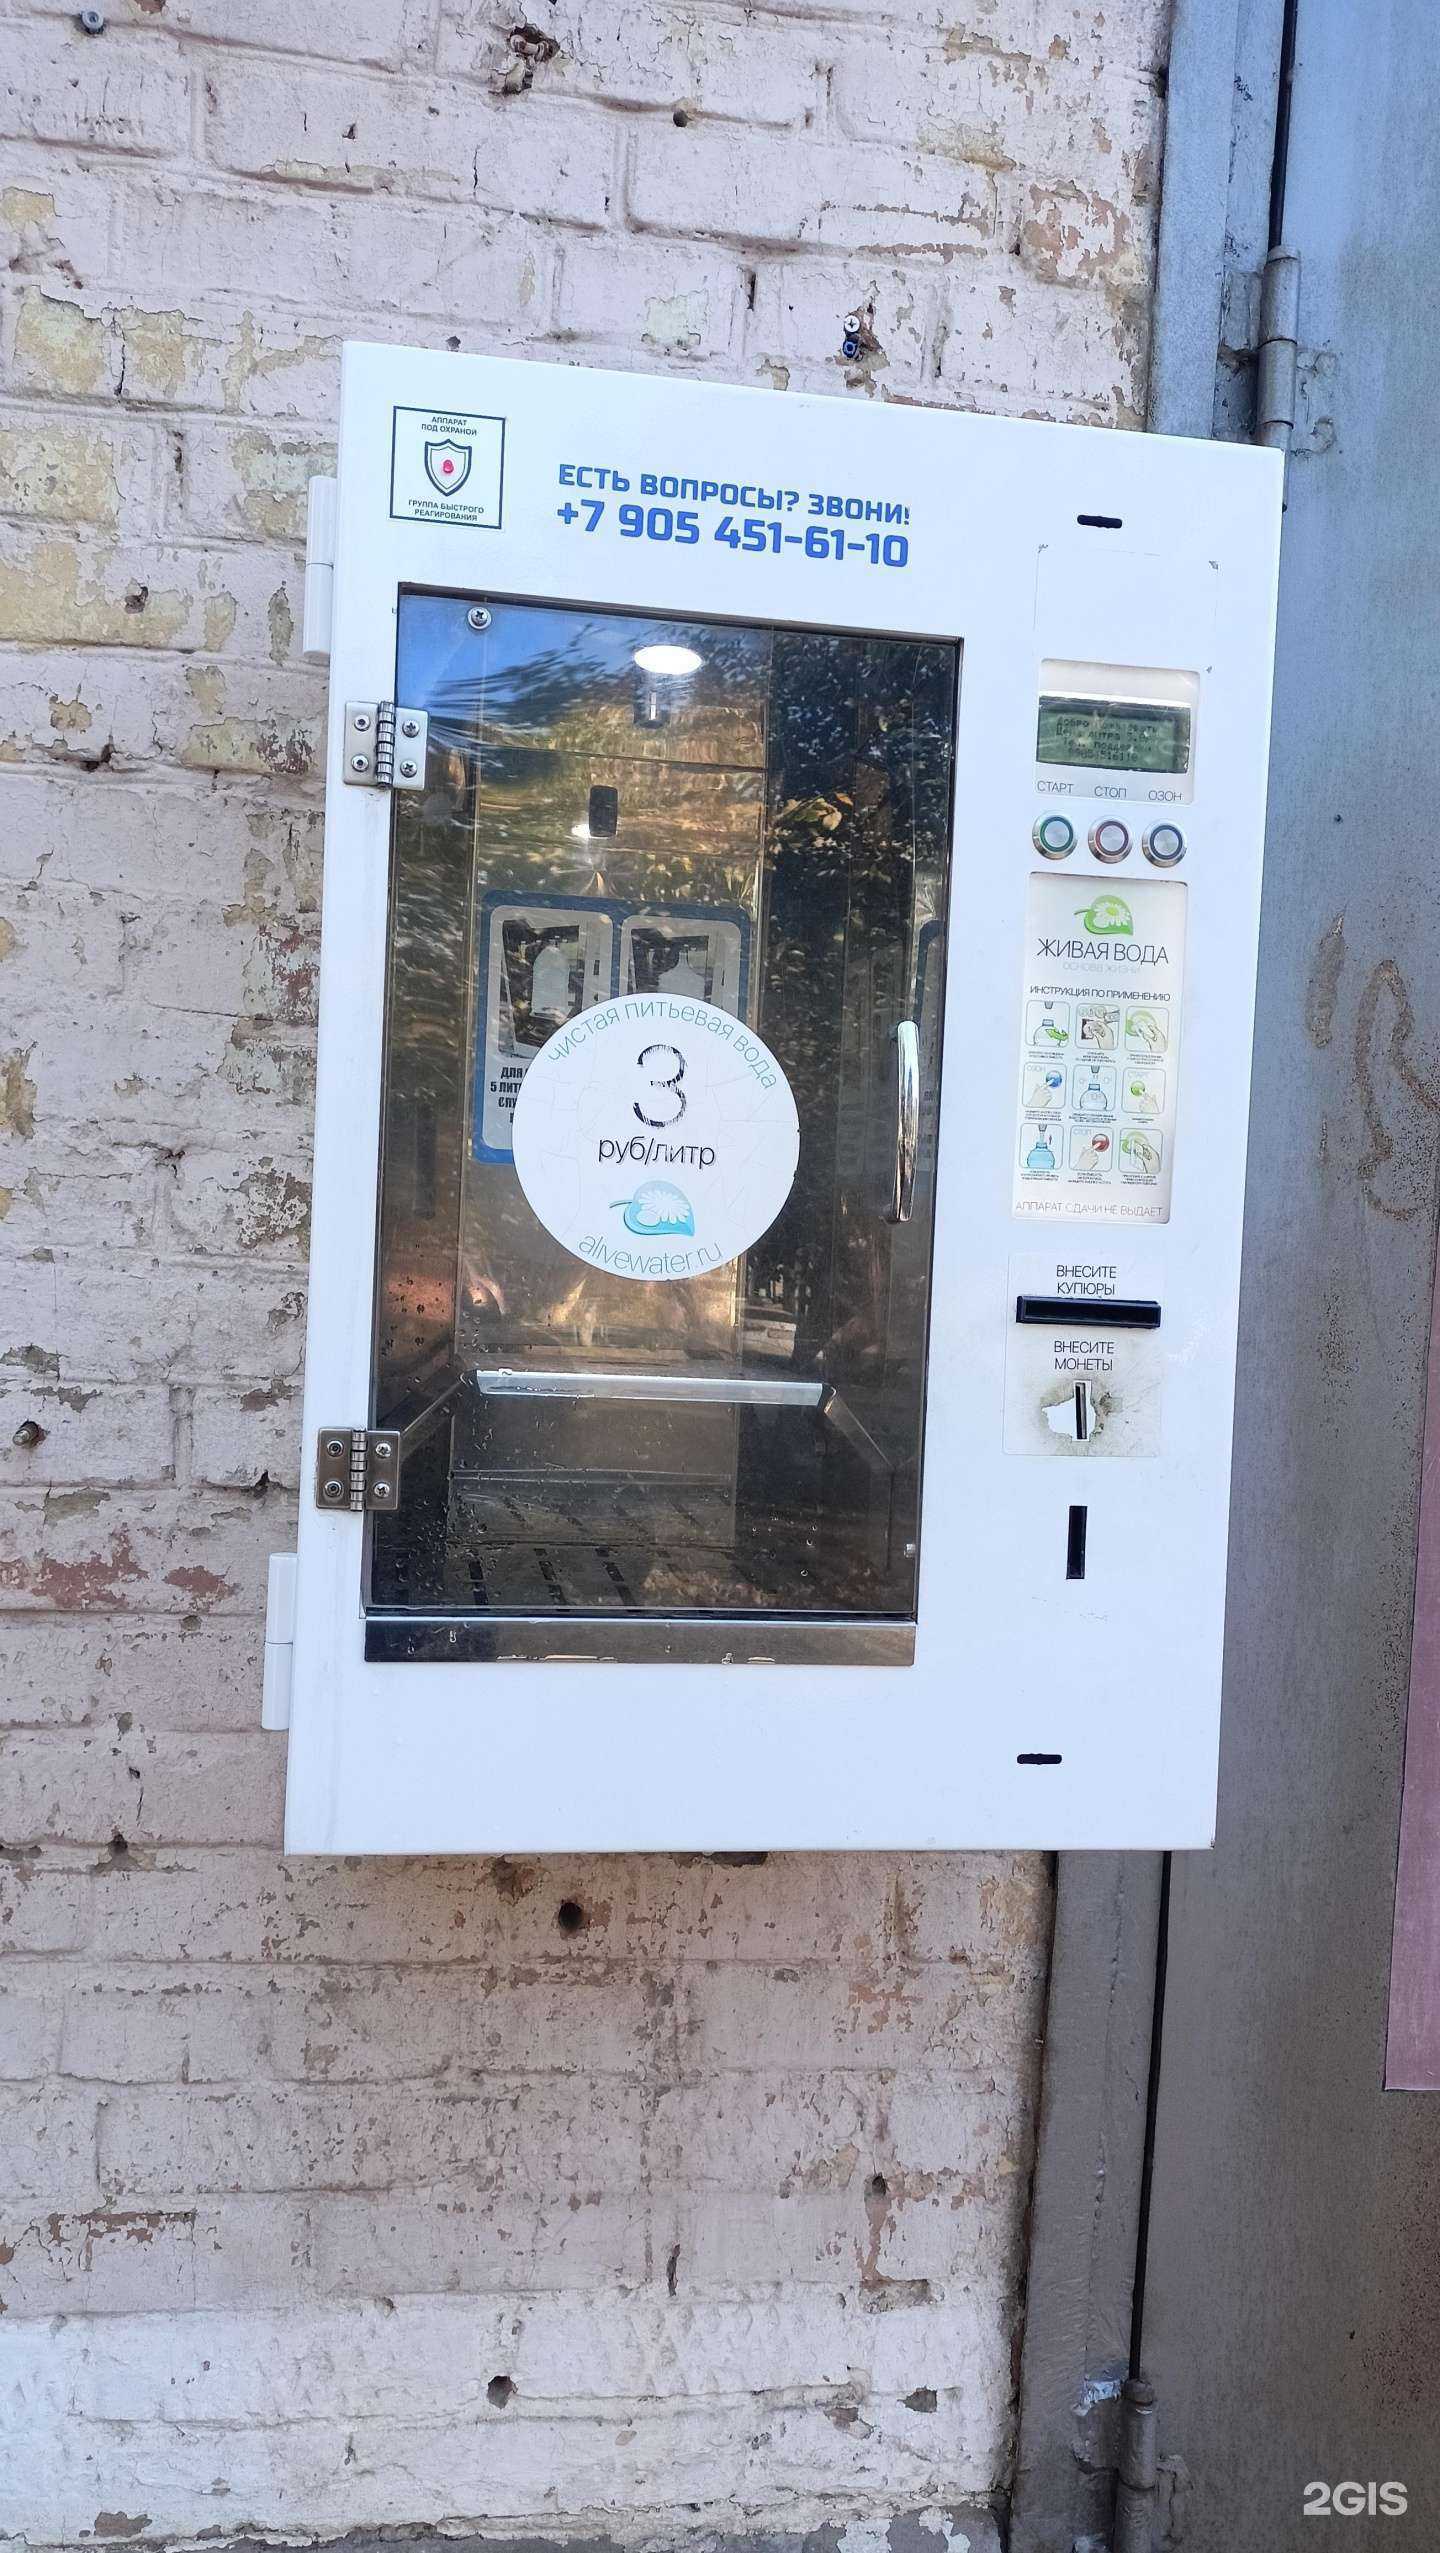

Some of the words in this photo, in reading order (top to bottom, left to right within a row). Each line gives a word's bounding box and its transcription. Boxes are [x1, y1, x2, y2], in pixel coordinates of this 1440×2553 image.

[431, 416, 467, 426] АППАРАТ
[421, 423, 438, 432] ПОД
[439, 425, 477, 436] ОХРАНОЙ
[558, 463, 630, 492] ЕСТЬ
[640, 473, 800, 512] ВОПРОСЫ?
[807, 493, 911, 525] ЗВОНИ!
[408, 499, 438, 509] ГРУППА
[440, 503, 484, 514] БЫСТРОГО
[414, 509, 478, 521] РЕАГИРОВАНИЯ
[556, 499, 605, 532] +7
[618, 503, 700, 544] 905
[713, 516, 909, 568] 451-61-10
[1037, 780, 1074, 793] СТАРТ
[1094, 786, 1127, 798] СТОП
[1148, 790, 1182, 801] ОЗОН
[1037, 938, 1109, 960] ЖИВАЯ
[1114, 943, 1169, 966] ВОДА
[1030, 985, 1090, 997] ИНСТРУКЦИЯ
[1091, 988, 1105, 998] ПО
[1106, 990, 1171, 1002] ПРИМЕНЕНИЮ
[548, 1007, 621, 1061] чистая
[624, 1001, 734, 1041] питьевая
[732, 1035, 777, 1089] вода
[501, 1066, 523, 1079] ДЛЯ
[490, 1081, 497, 1092] 5
[632, 1043, 688, 1129] 3
[598, 1135, 716, 1169] руб/литр
[1016, 1201, 1063, 1213] АППАРАТ
[1064, 1202, 1102, 1216] СДАЧИ
[1104, 1204, 1118, 1215] НЕ
[1120, 1205, 1163, 1217] ВЫДАЕТ
[1056, 1264, 1117, 1279] ВНЕСИТЕ
[1057, 1281, 1115, 1295] КУПЮРЫ
[1054, 1341, 1115, 1354] ВНЕСИТЕ
[1054, 1357, 1113, 1371] МОНЕТЫ
